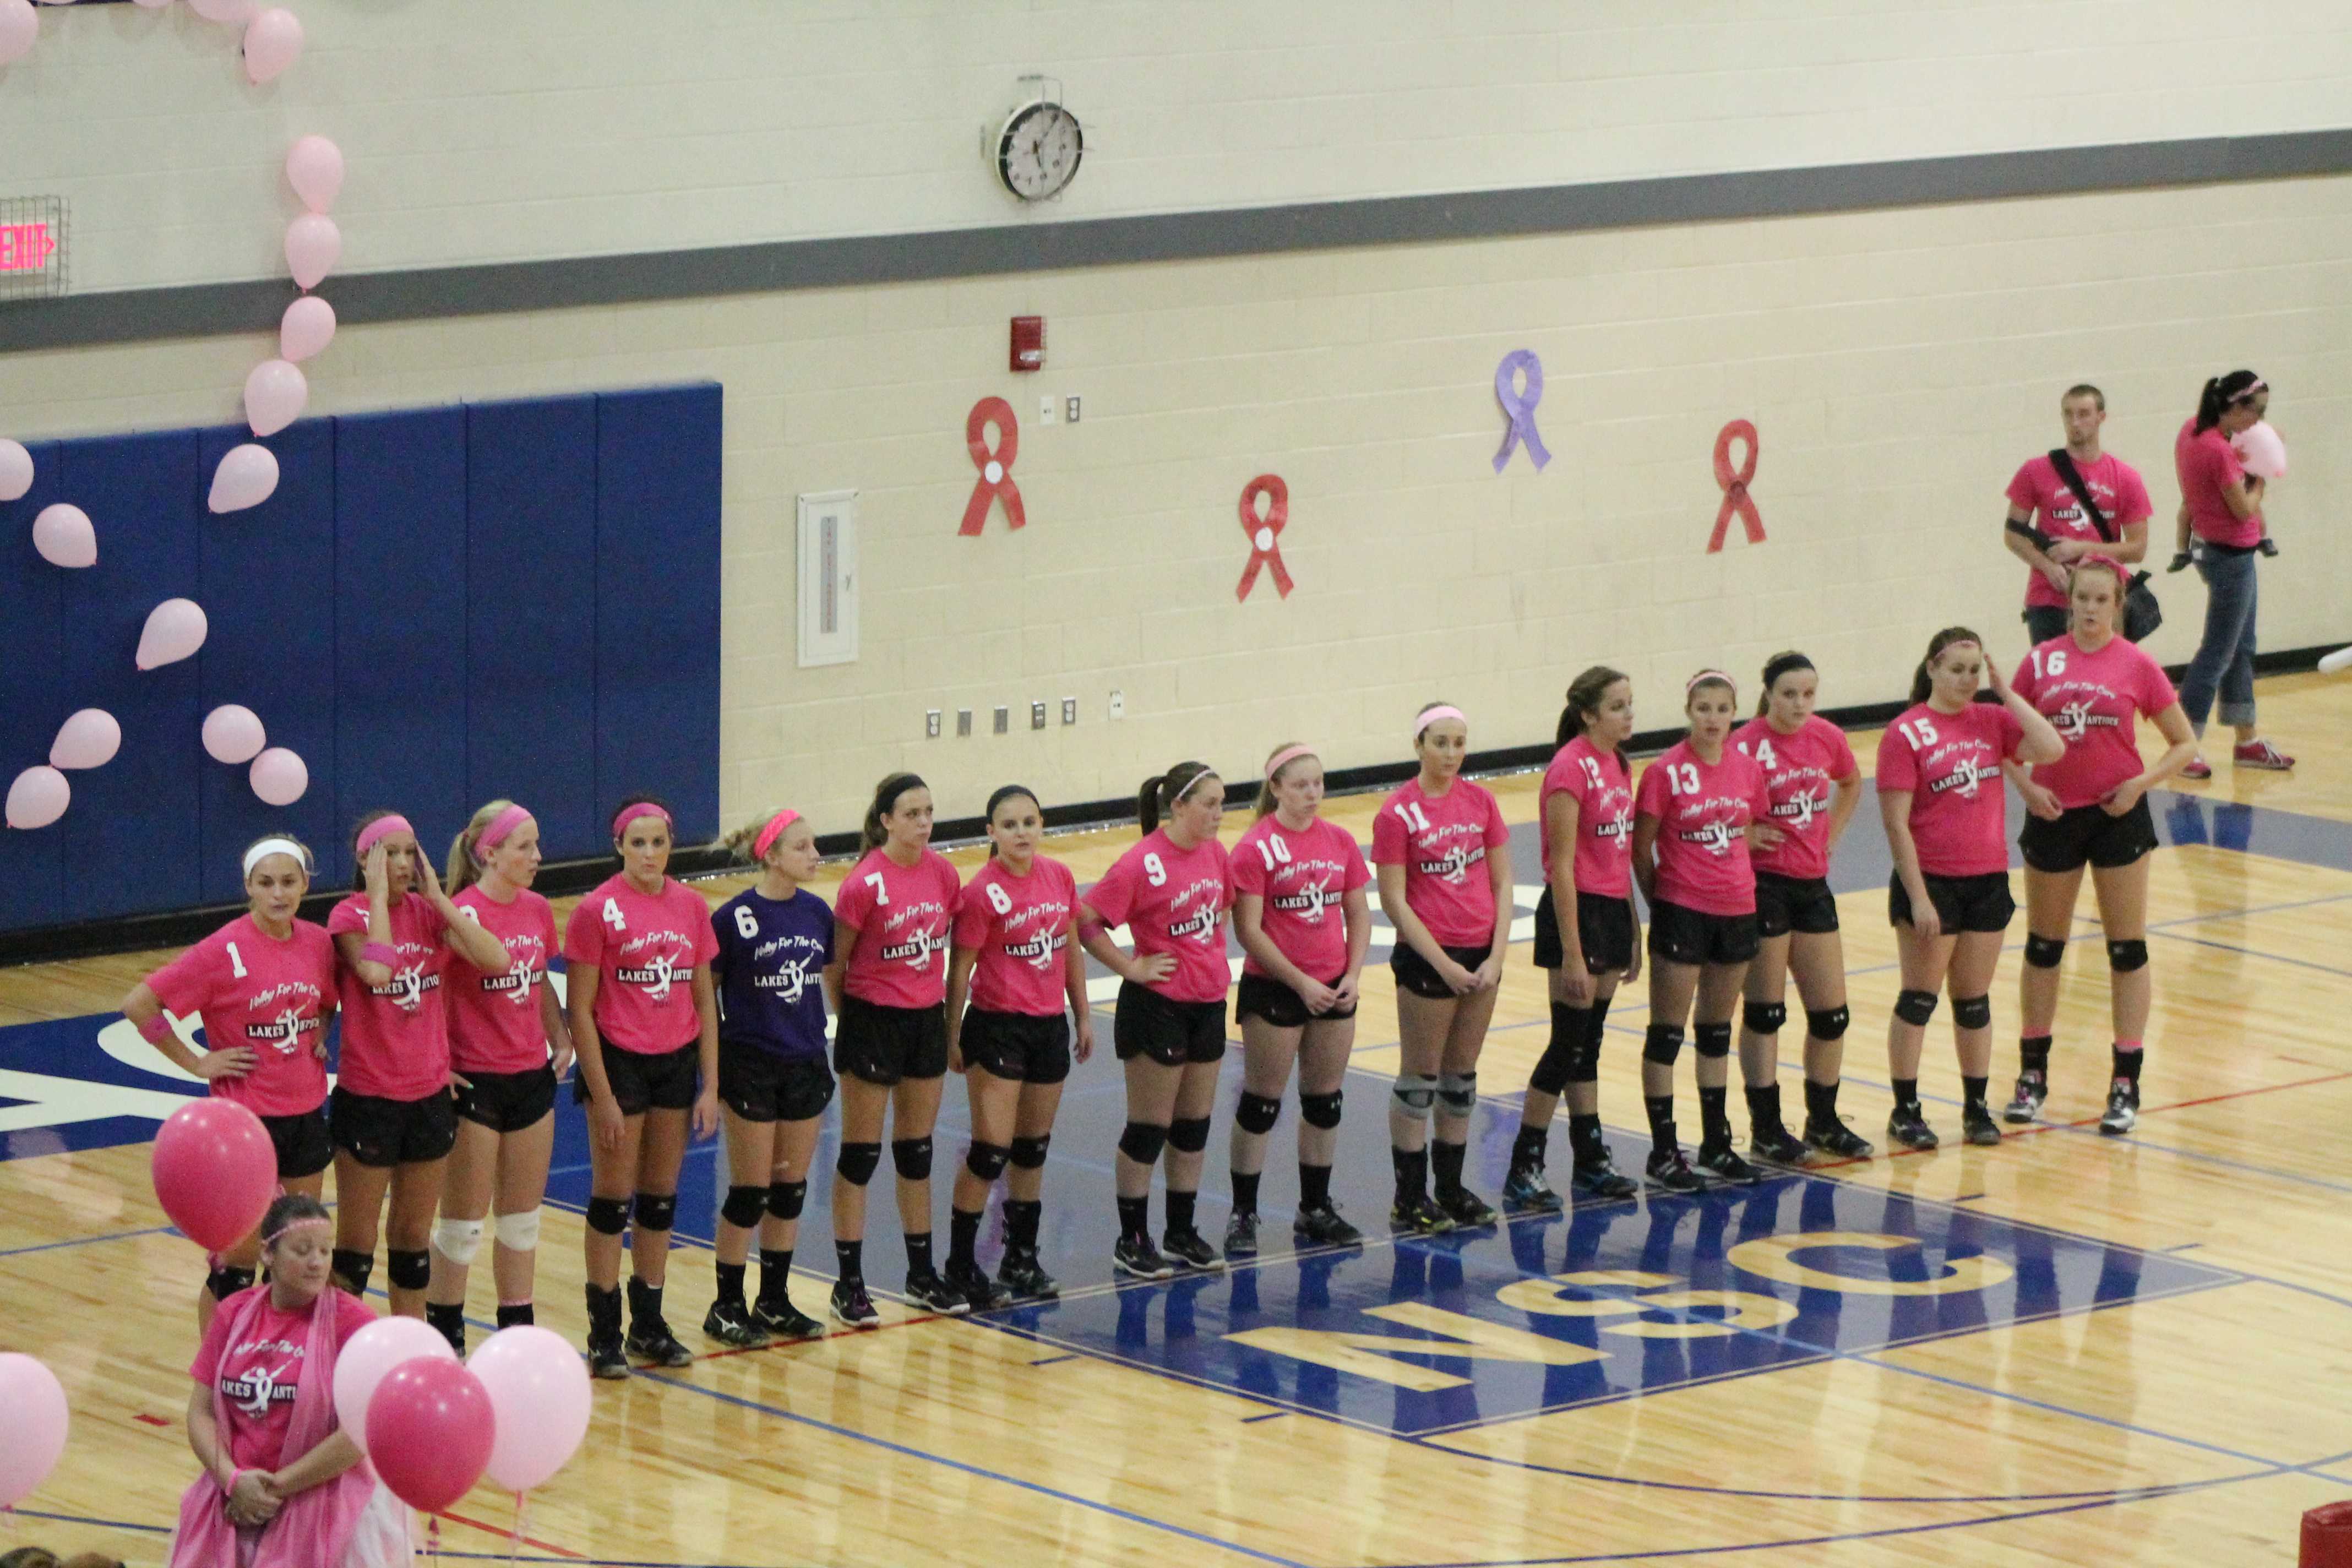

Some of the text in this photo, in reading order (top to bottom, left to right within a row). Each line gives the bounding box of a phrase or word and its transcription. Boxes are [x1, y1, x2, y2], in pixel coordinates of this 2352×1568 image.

[0, 224, 46, 270] EXIT
[2031, 650, 2066, 680] 16
[1898, 717, 1937, 752] 15
[1578, 756, 1604, 790] 12
[1666, 763, 1701, 796] 13
[1931, 773, 1965, 792] LAKES
[1703, 798, 1718, 810] For
[1718, 797, 1734, 807] The
[1394, 801, 1430, 834] 11
[1439, 826, 1452, 839] For
[1452, 824, 1468, 835] The
[1256, 833, 1292, 872] 10
[1144, 852, 1167, 887] 9
[1296, 862, 1310, 875] For
[1310, 859, 1326, 870] The
[1420, 861, 1454, 874] LAKES
[864, 872, 889, 906] 7
[986, 882, 1012, 914] 8
[1275, 896, 1309, 908] LAKES
[602, 897, 626, 931] 4
[906, 905, 919, 919] For
[920, 902, 934, 915] The
[1028, 906, 1040, 919] For
[1040, 902, 1055, 914] The
[734, 905, 759, 939] 6
[1170, 918, 1201, 936] LAKES
[518, 935, 532, 948] The
[646, 932, 662, 946] For
[663, 930, 678, 943] The
[778, 937, 793, 950] For
[794, 935, 809, 948] The
[396, 946, 405, 955] or
[883, 943, 917, 960] LAKES
[1005, 944, 1040, 956] LAKES
[226, 941, 247, 978] 1
[484, 976, 518, 990] LAKES
[618, 970, 655, 982] LAKES
[754, 975, 788, 987] LAKES
[277, 983, 292, 998] For
[293, 982, 308, 995] The
[249, 1025, 285, 1037] LAKES
[1220, 1232, 2013, 1392] NSC
